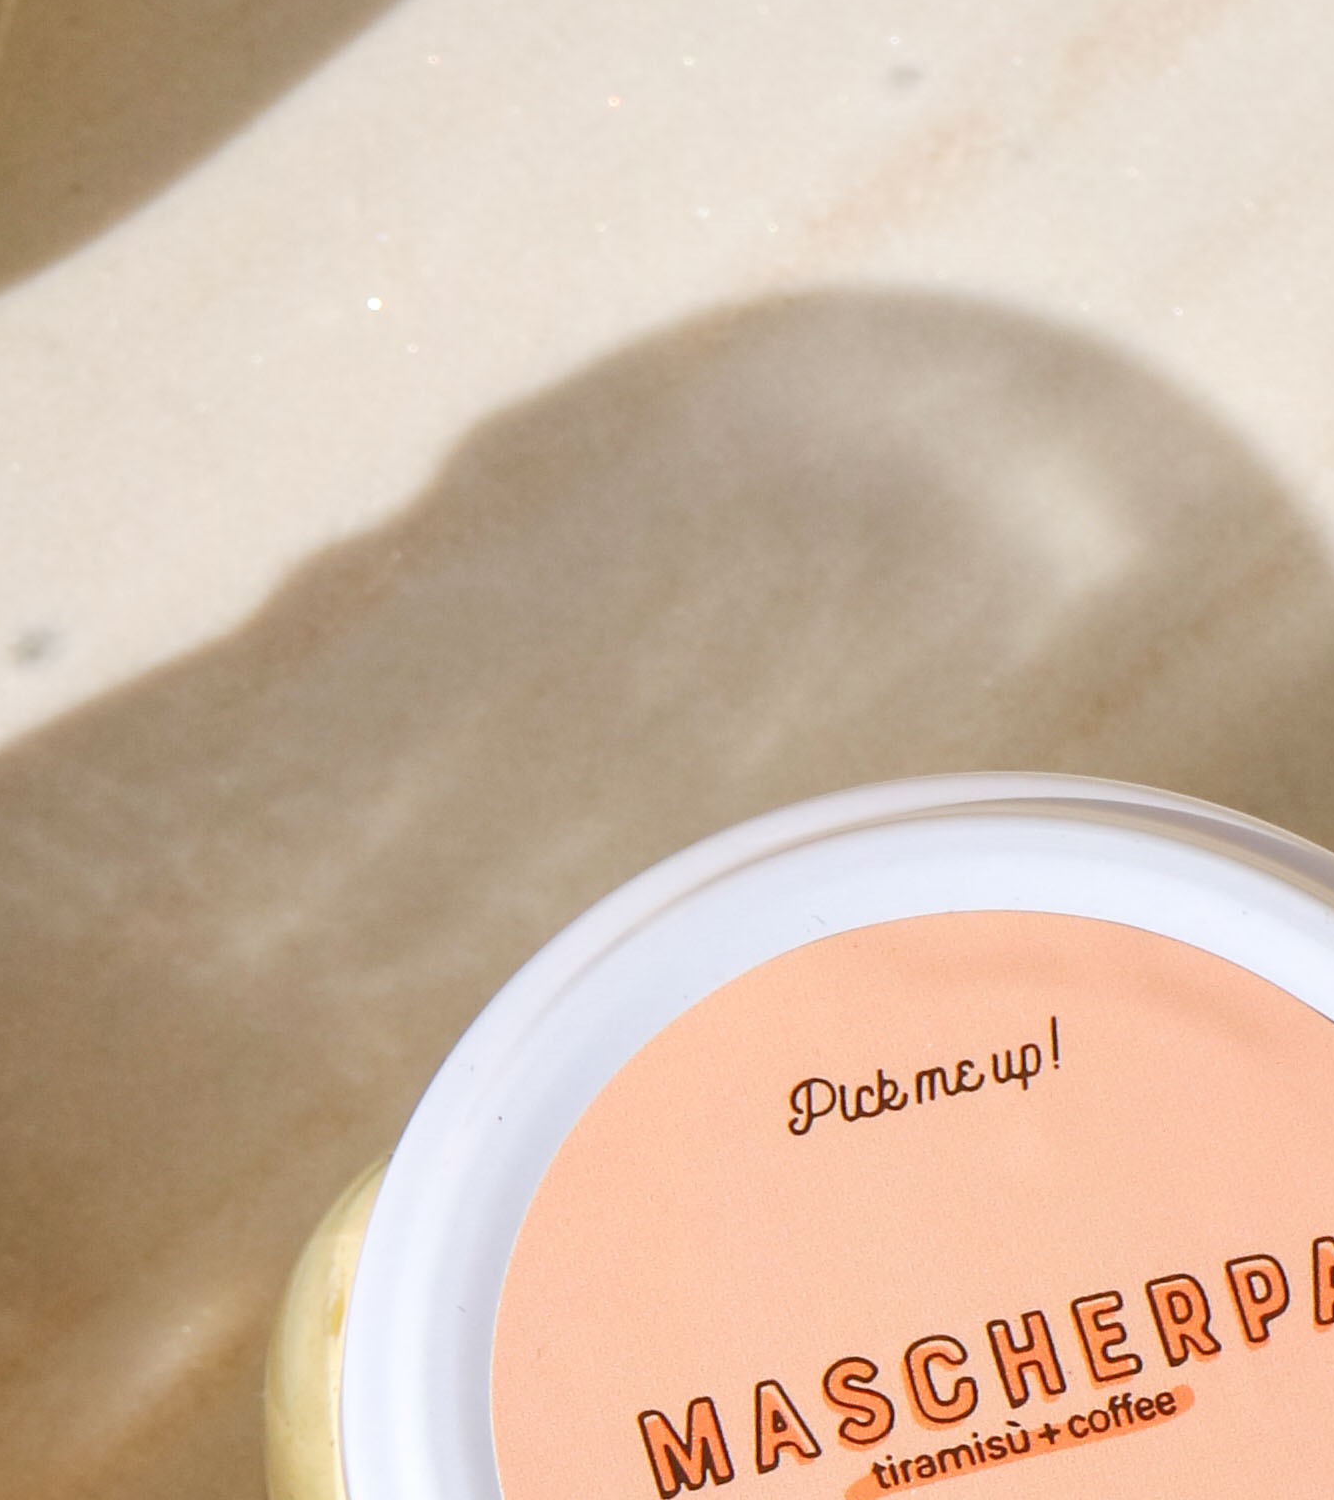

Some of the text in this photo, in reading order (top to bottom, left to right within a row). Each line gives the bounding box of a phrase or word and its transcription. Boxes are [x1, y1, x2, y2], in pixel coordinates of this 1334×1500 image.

[787, 1015, 1060, 1136] Pick me up!
[871, 1390, 1179, 1490] tiramisù + coffee
